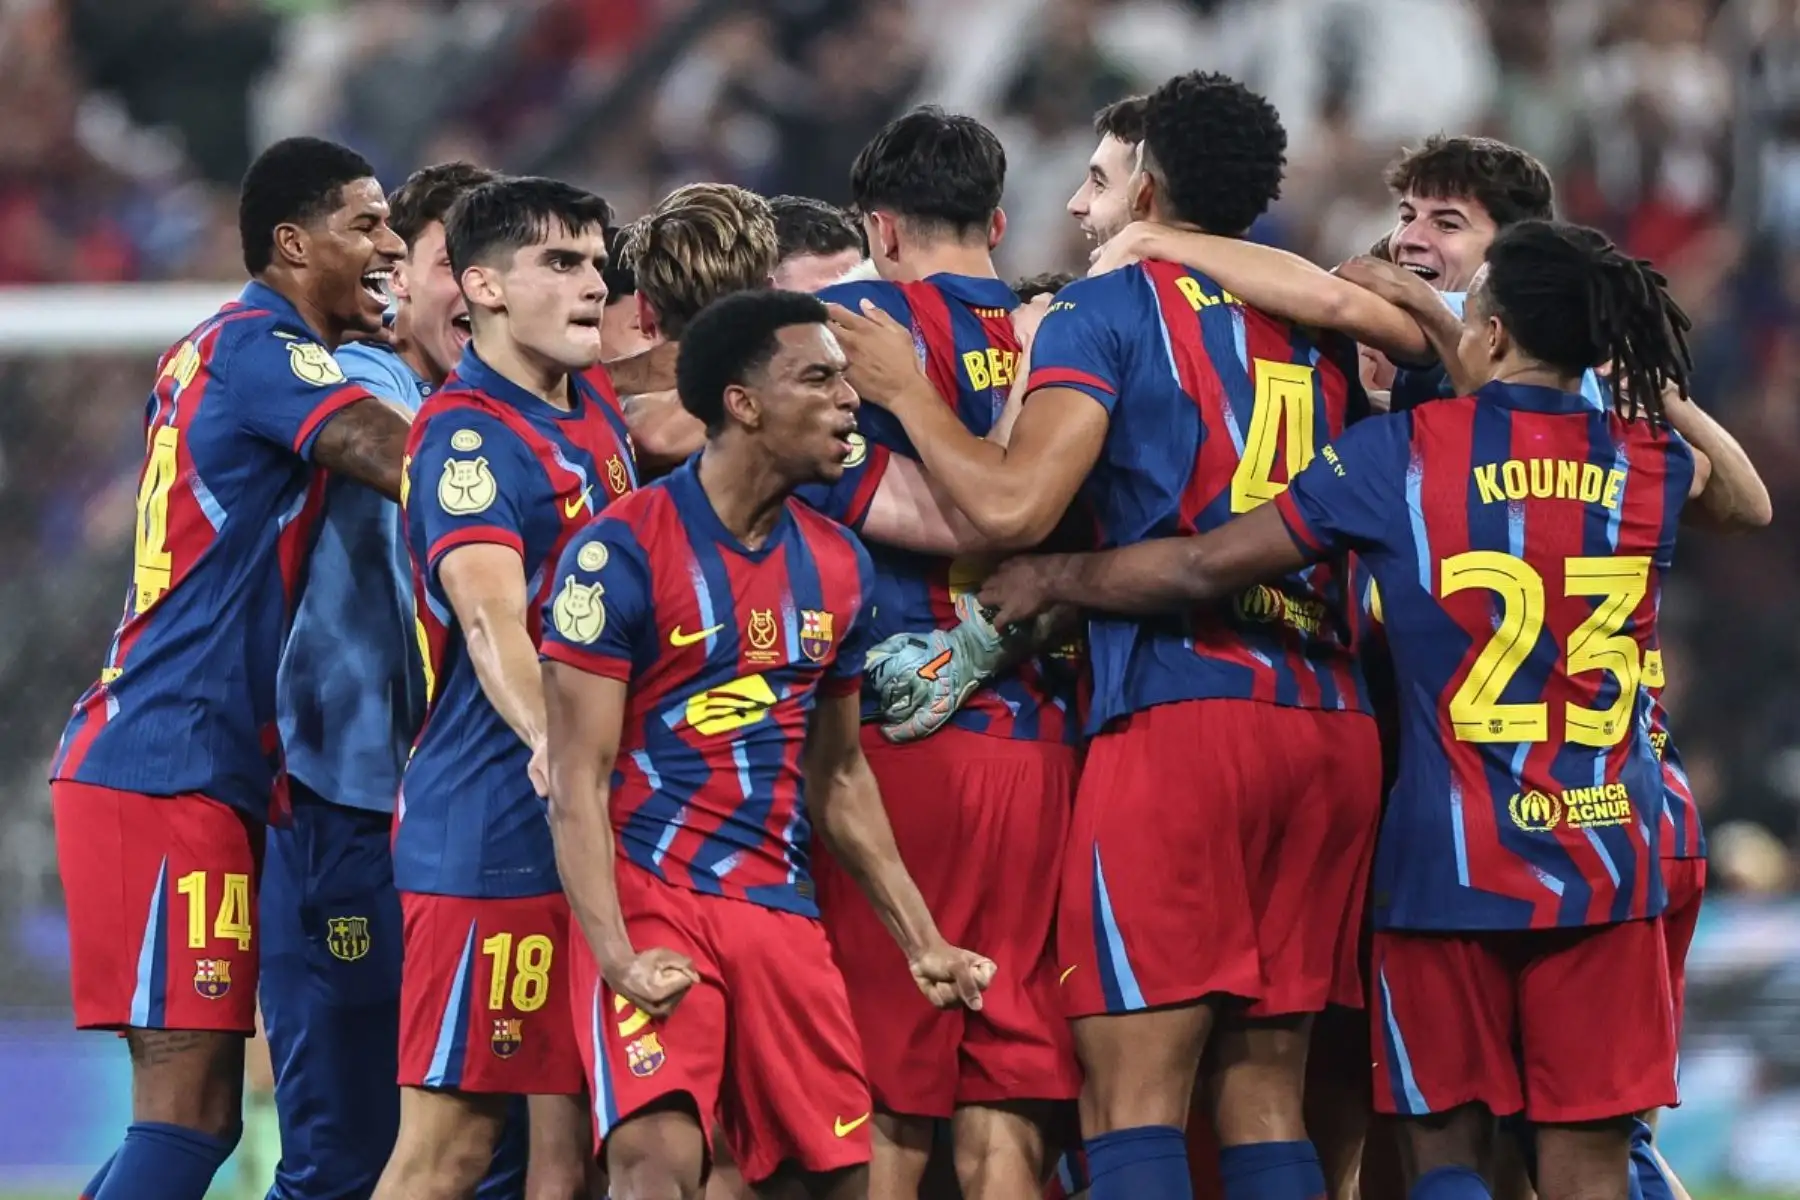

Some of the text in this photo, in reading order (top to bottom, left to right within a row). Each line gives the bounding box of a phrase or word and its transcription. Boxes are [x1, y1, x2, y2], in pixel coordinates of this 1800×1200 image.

[1231, 357, 1315, 514] 4
[133, 423, 179, 614] 4
[1473, 458, 1627, 509] KOUNDE
[1440, 550, 1652, 747] 23
[1561, 783, 1628, 806] UNHCR
[1567, 800, 1631, 822] ACNUR
[177, 870, 252, 951] 14
[482, 932, 554, 1012] 18
